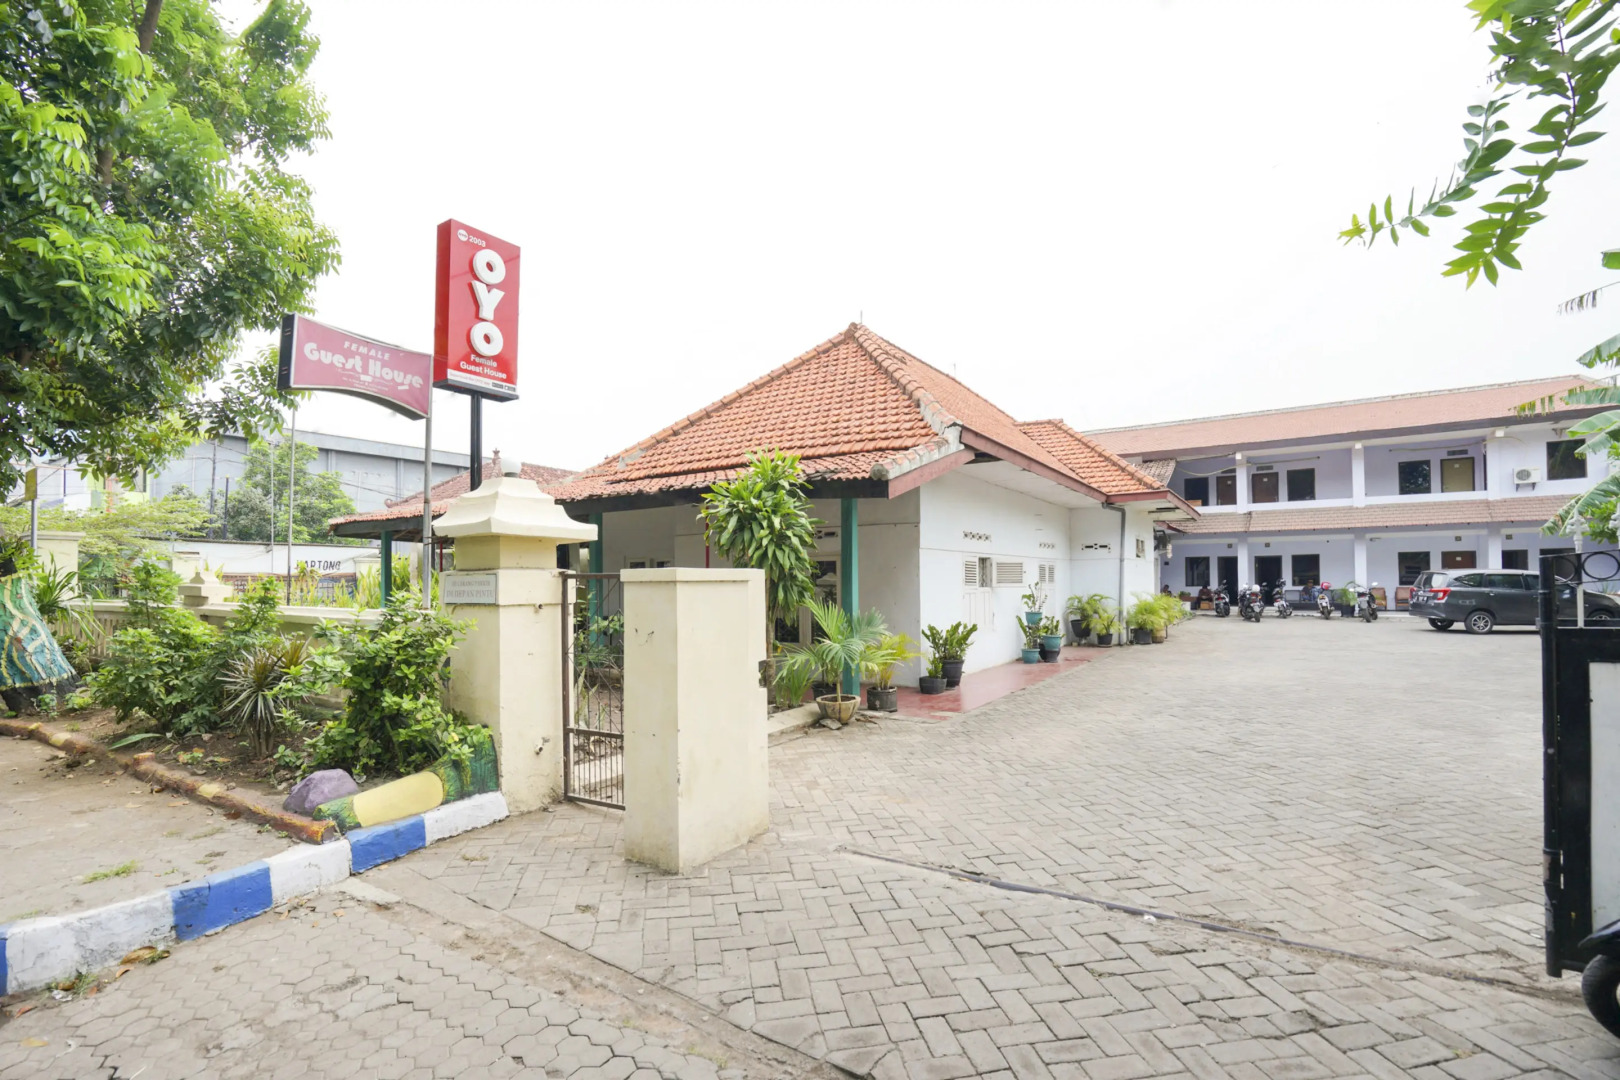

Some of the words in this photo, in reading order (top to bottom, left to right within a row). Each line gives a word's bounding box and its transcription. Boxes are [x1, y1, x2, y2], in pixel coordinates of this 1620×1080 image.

[469, 235, 486, 248] 2003
[470, 249, 506, 357] OYO
[343, 341, 391, 361] FEMALE
[470, 354, 498, 368] Female
[303, 342, 363, 373] Guest
[368, 359, 424, 389] House
[459, 360, 483, 374] Guest
[484, 366, 507, 380] House
